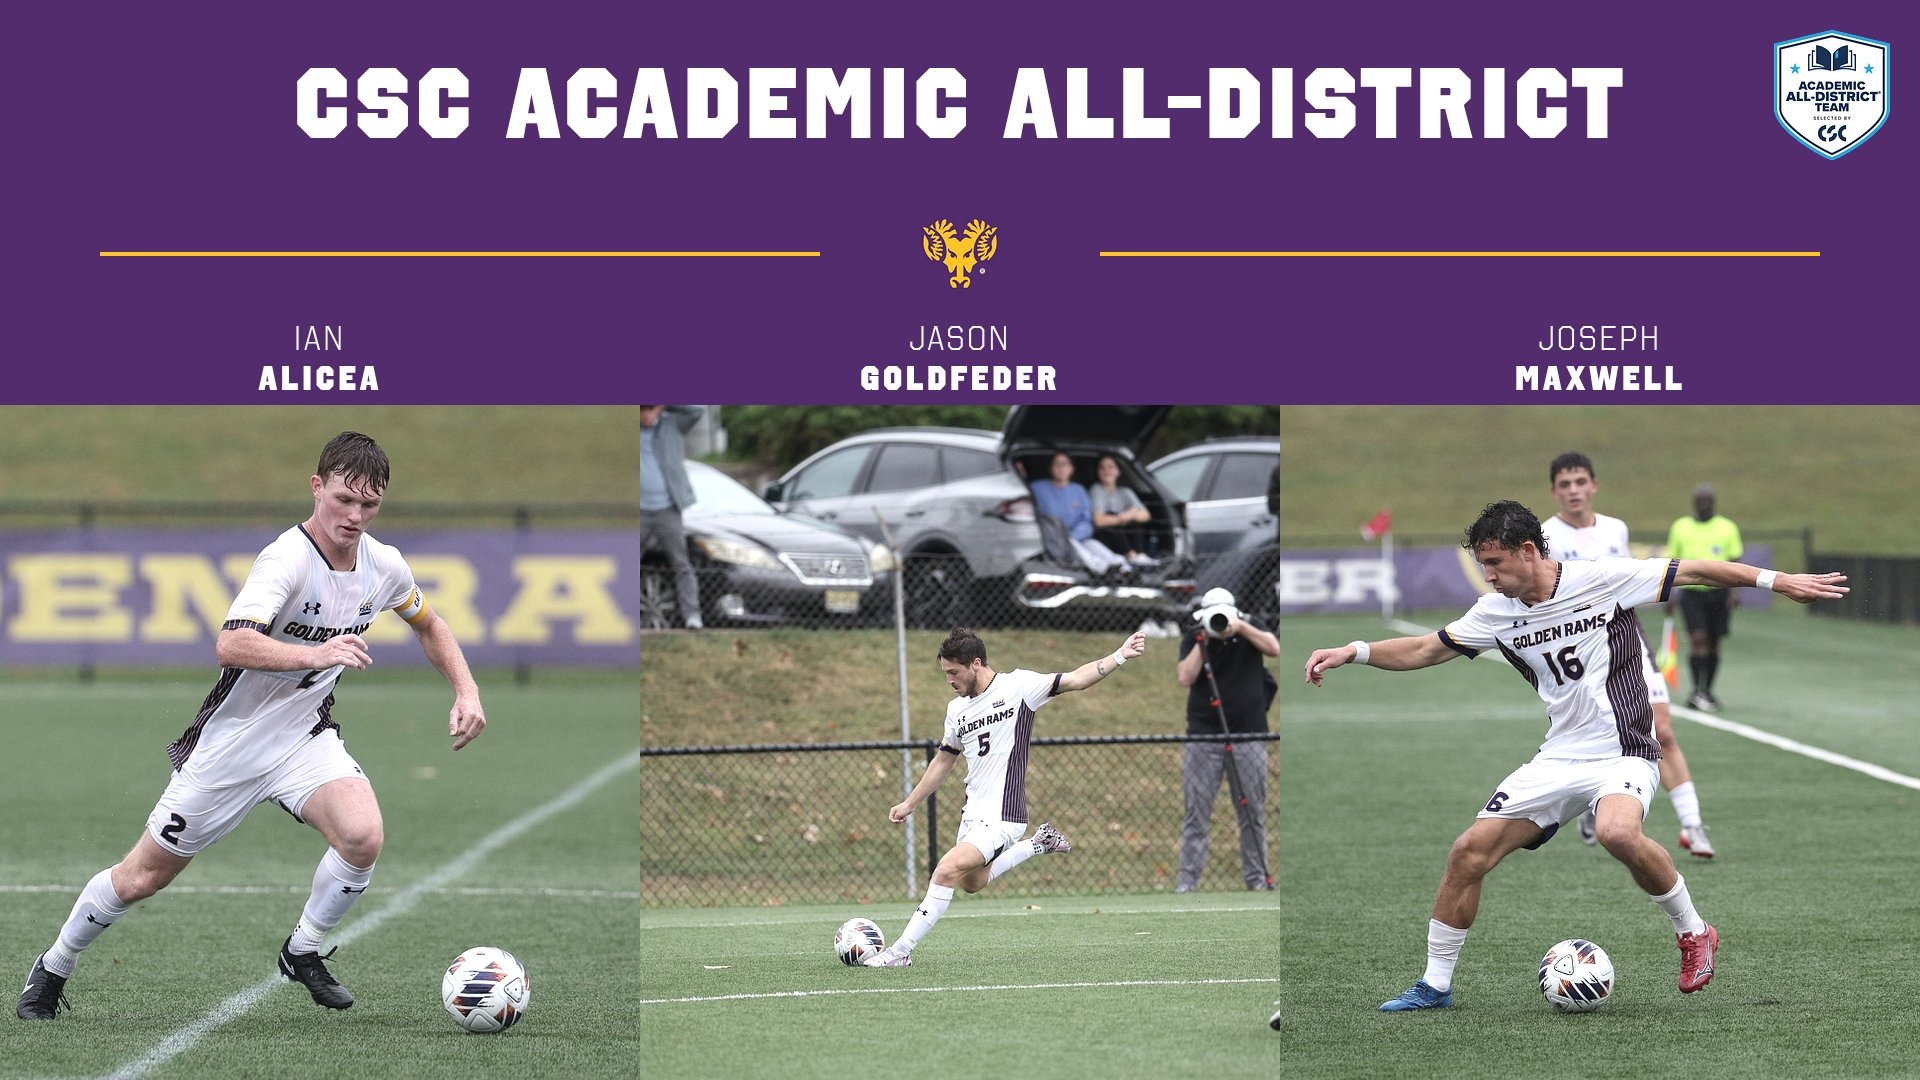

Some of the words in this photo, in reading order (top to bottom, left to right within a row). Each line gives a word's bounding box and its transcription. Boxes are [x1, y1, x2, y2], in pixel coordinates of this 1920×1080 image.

[1513, 624, 1562, 650] GOLDEN
[1564, 613, 1607, 637] RAMS
[1542, 645, 1585, 687] 16
[957, 717, 985, 738] OLDEN
[986, 707, 1015, 726] RAMS
[977, 731, 991, 757] 5
[160, 812, 188, 846] 2
